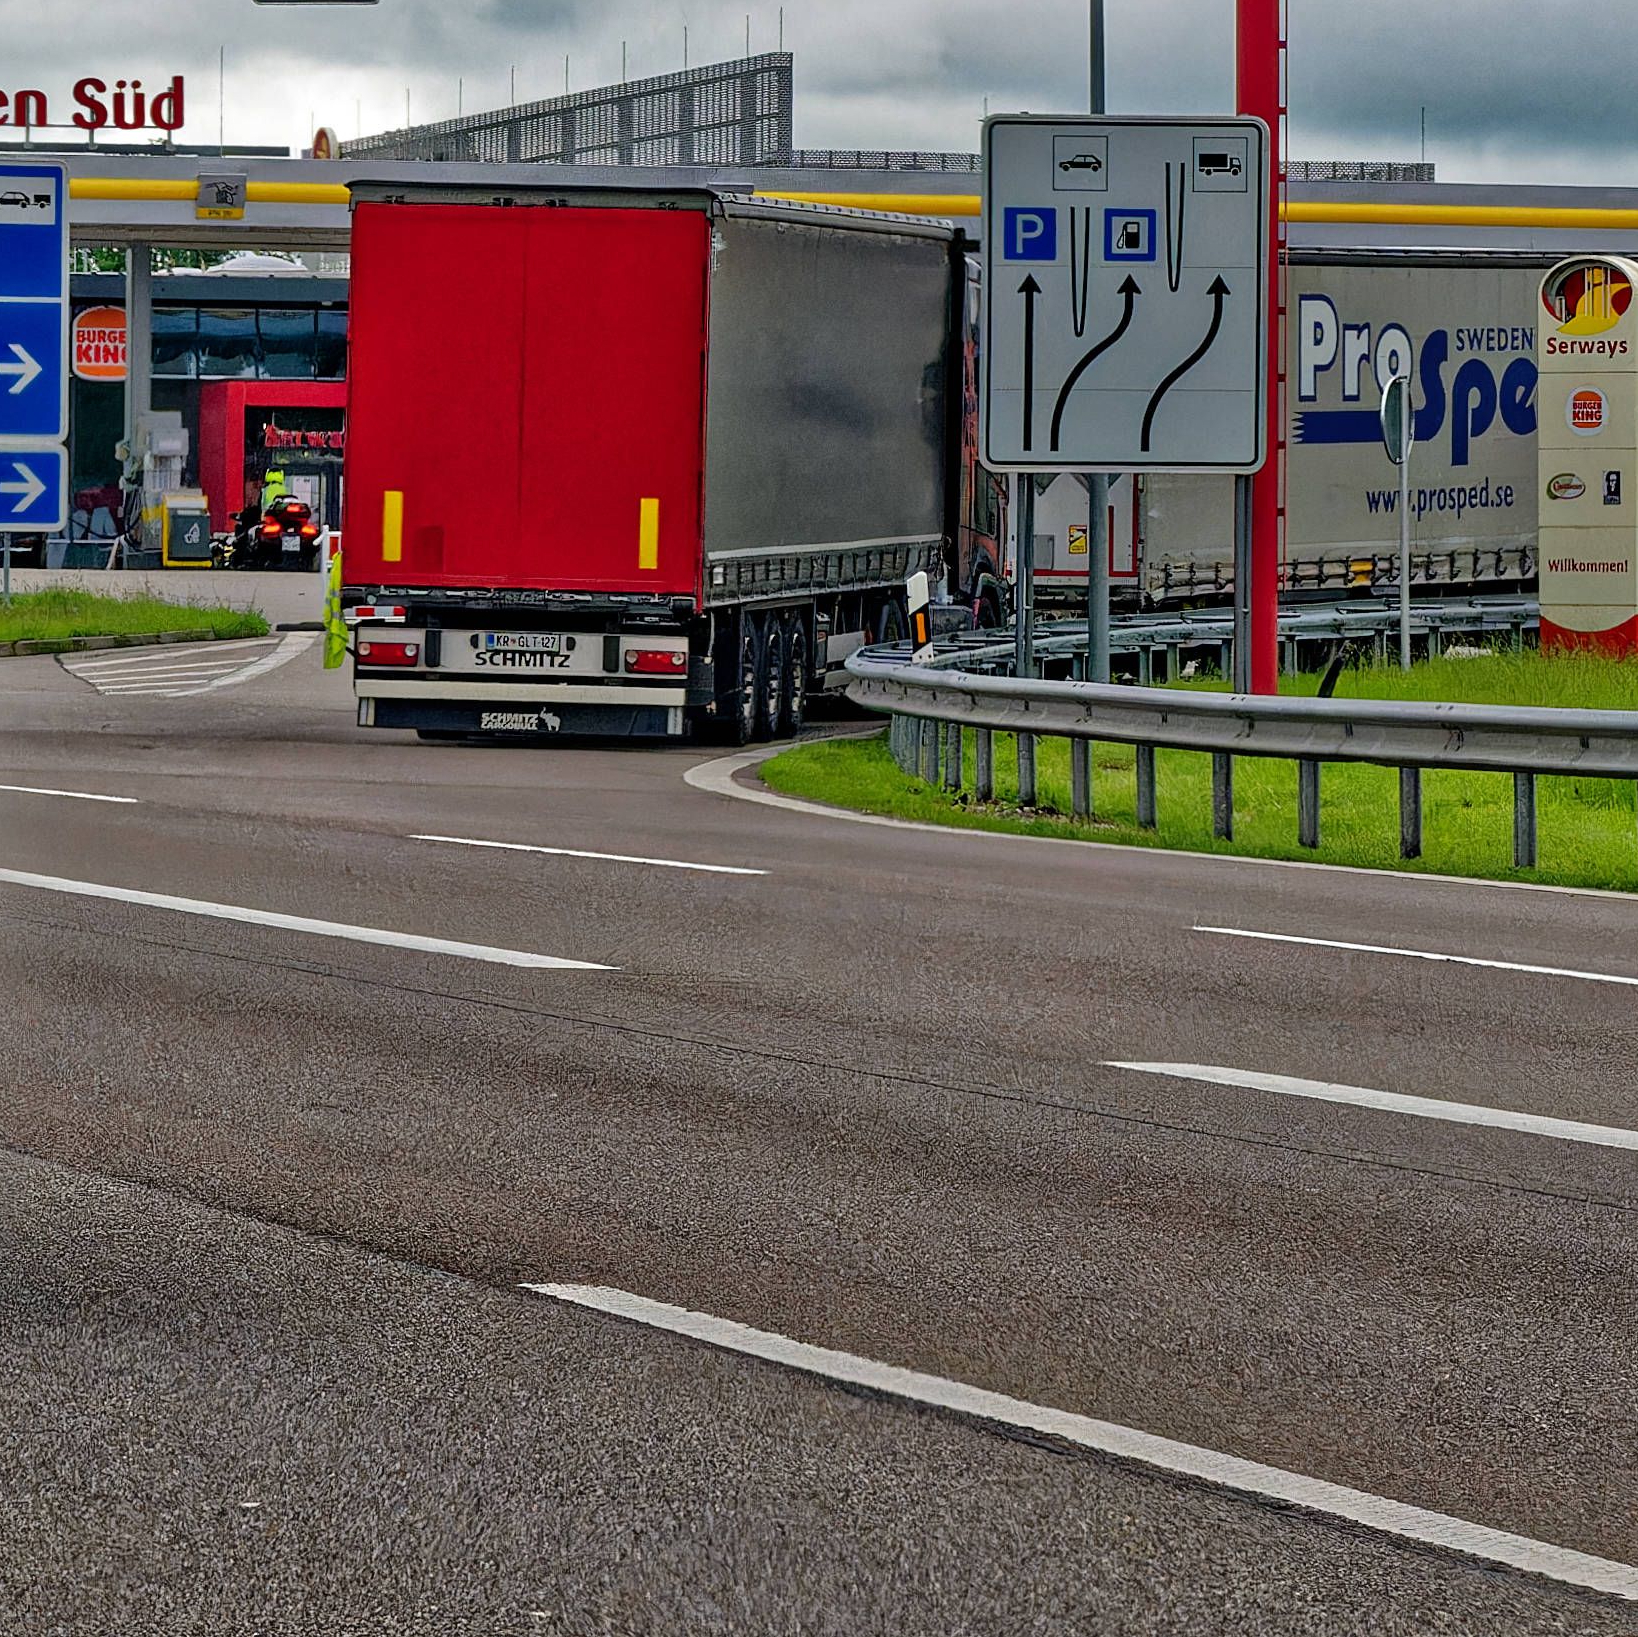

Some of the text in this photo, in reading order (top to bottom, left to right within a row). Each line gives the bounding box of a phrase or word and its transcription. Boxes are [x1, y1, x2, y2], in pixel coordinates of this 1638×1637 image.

[72, 75, 185, 130] Süd
[76, 328, 126, 345] BURGE
[1456, 327, 1534, 352] SWEDEN
[1546, 337, 1628, 359] Serways
[1414, 328, 1539, 466] Spe
[1572, 410, 1602, 421] KING
[1548, 558, 1628, 573] Willkommen!
[474, 651, 571, 668] SCHMITZ
[481, 712, 539, 723] SCHMITZ
